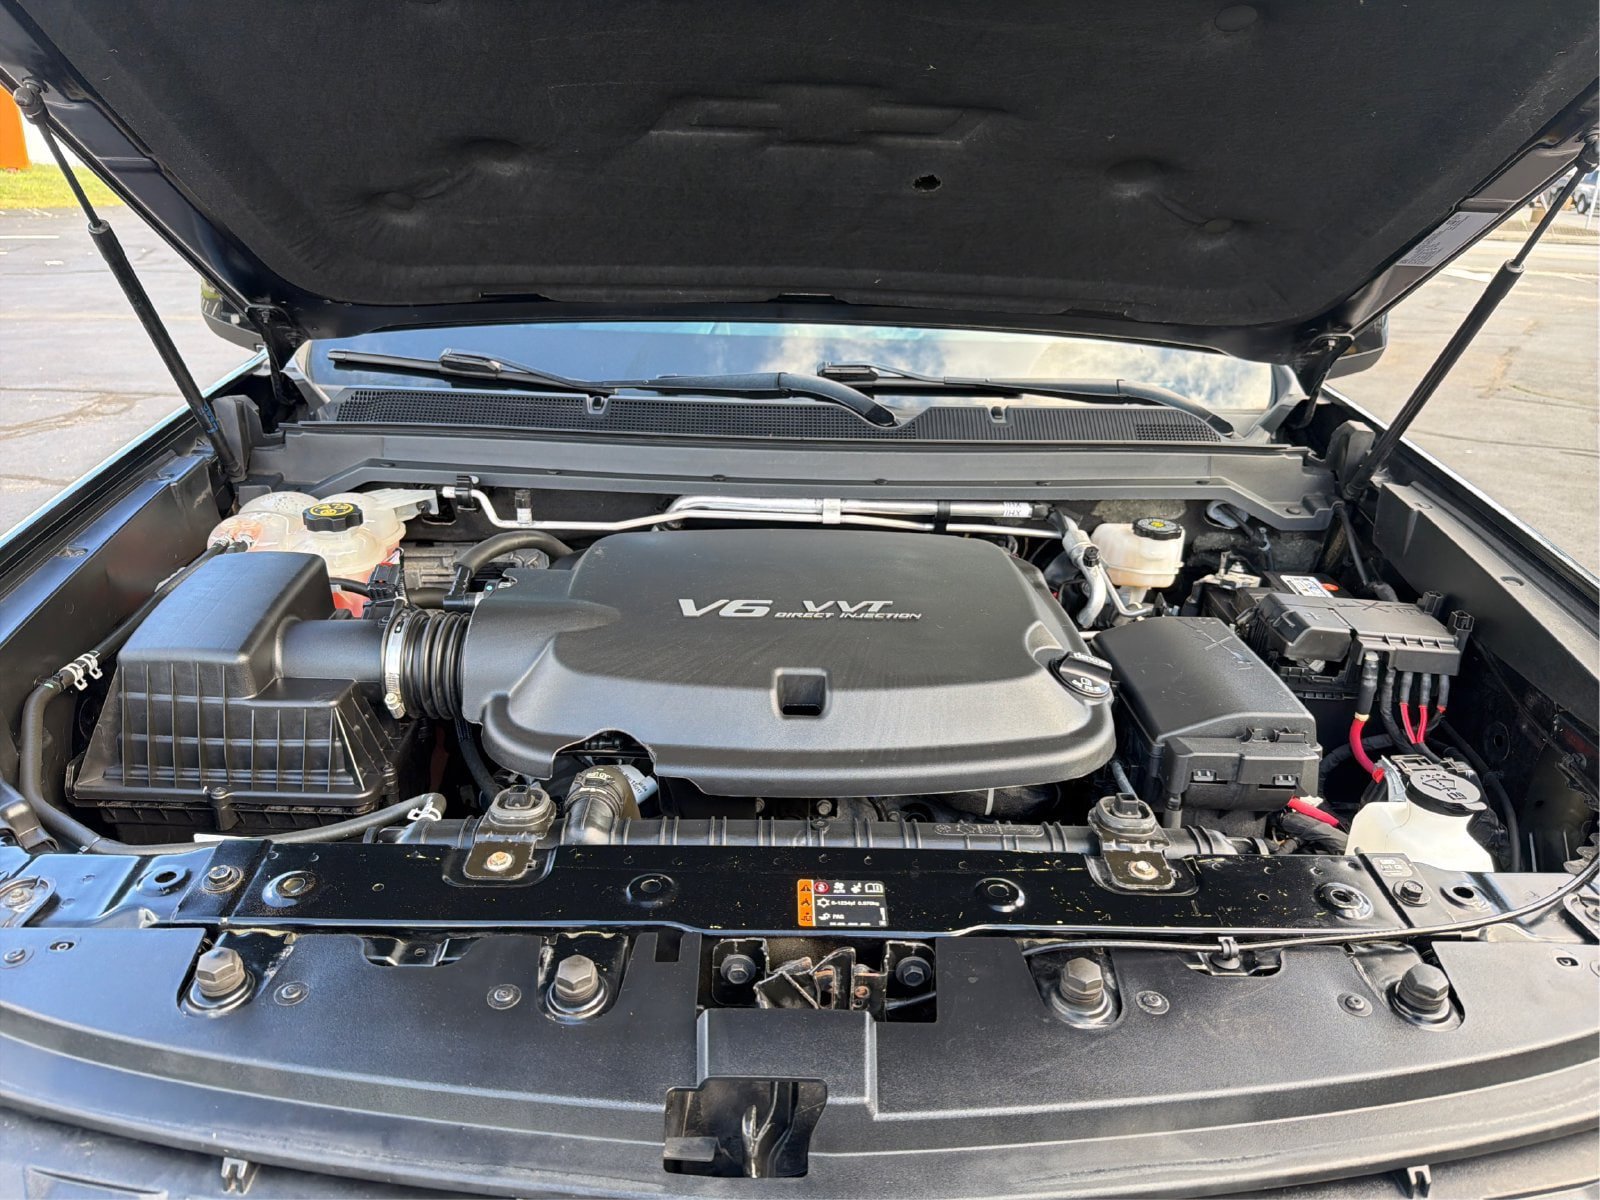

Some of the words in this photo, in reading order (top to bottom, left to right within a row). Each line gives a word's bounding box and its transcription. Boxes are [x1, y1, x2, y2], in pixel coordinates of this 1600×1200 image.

[678, 599, 773, 617] V6
[802, 600, 893, 612] VVT
[839, 612, 922, 620] INJECTION
